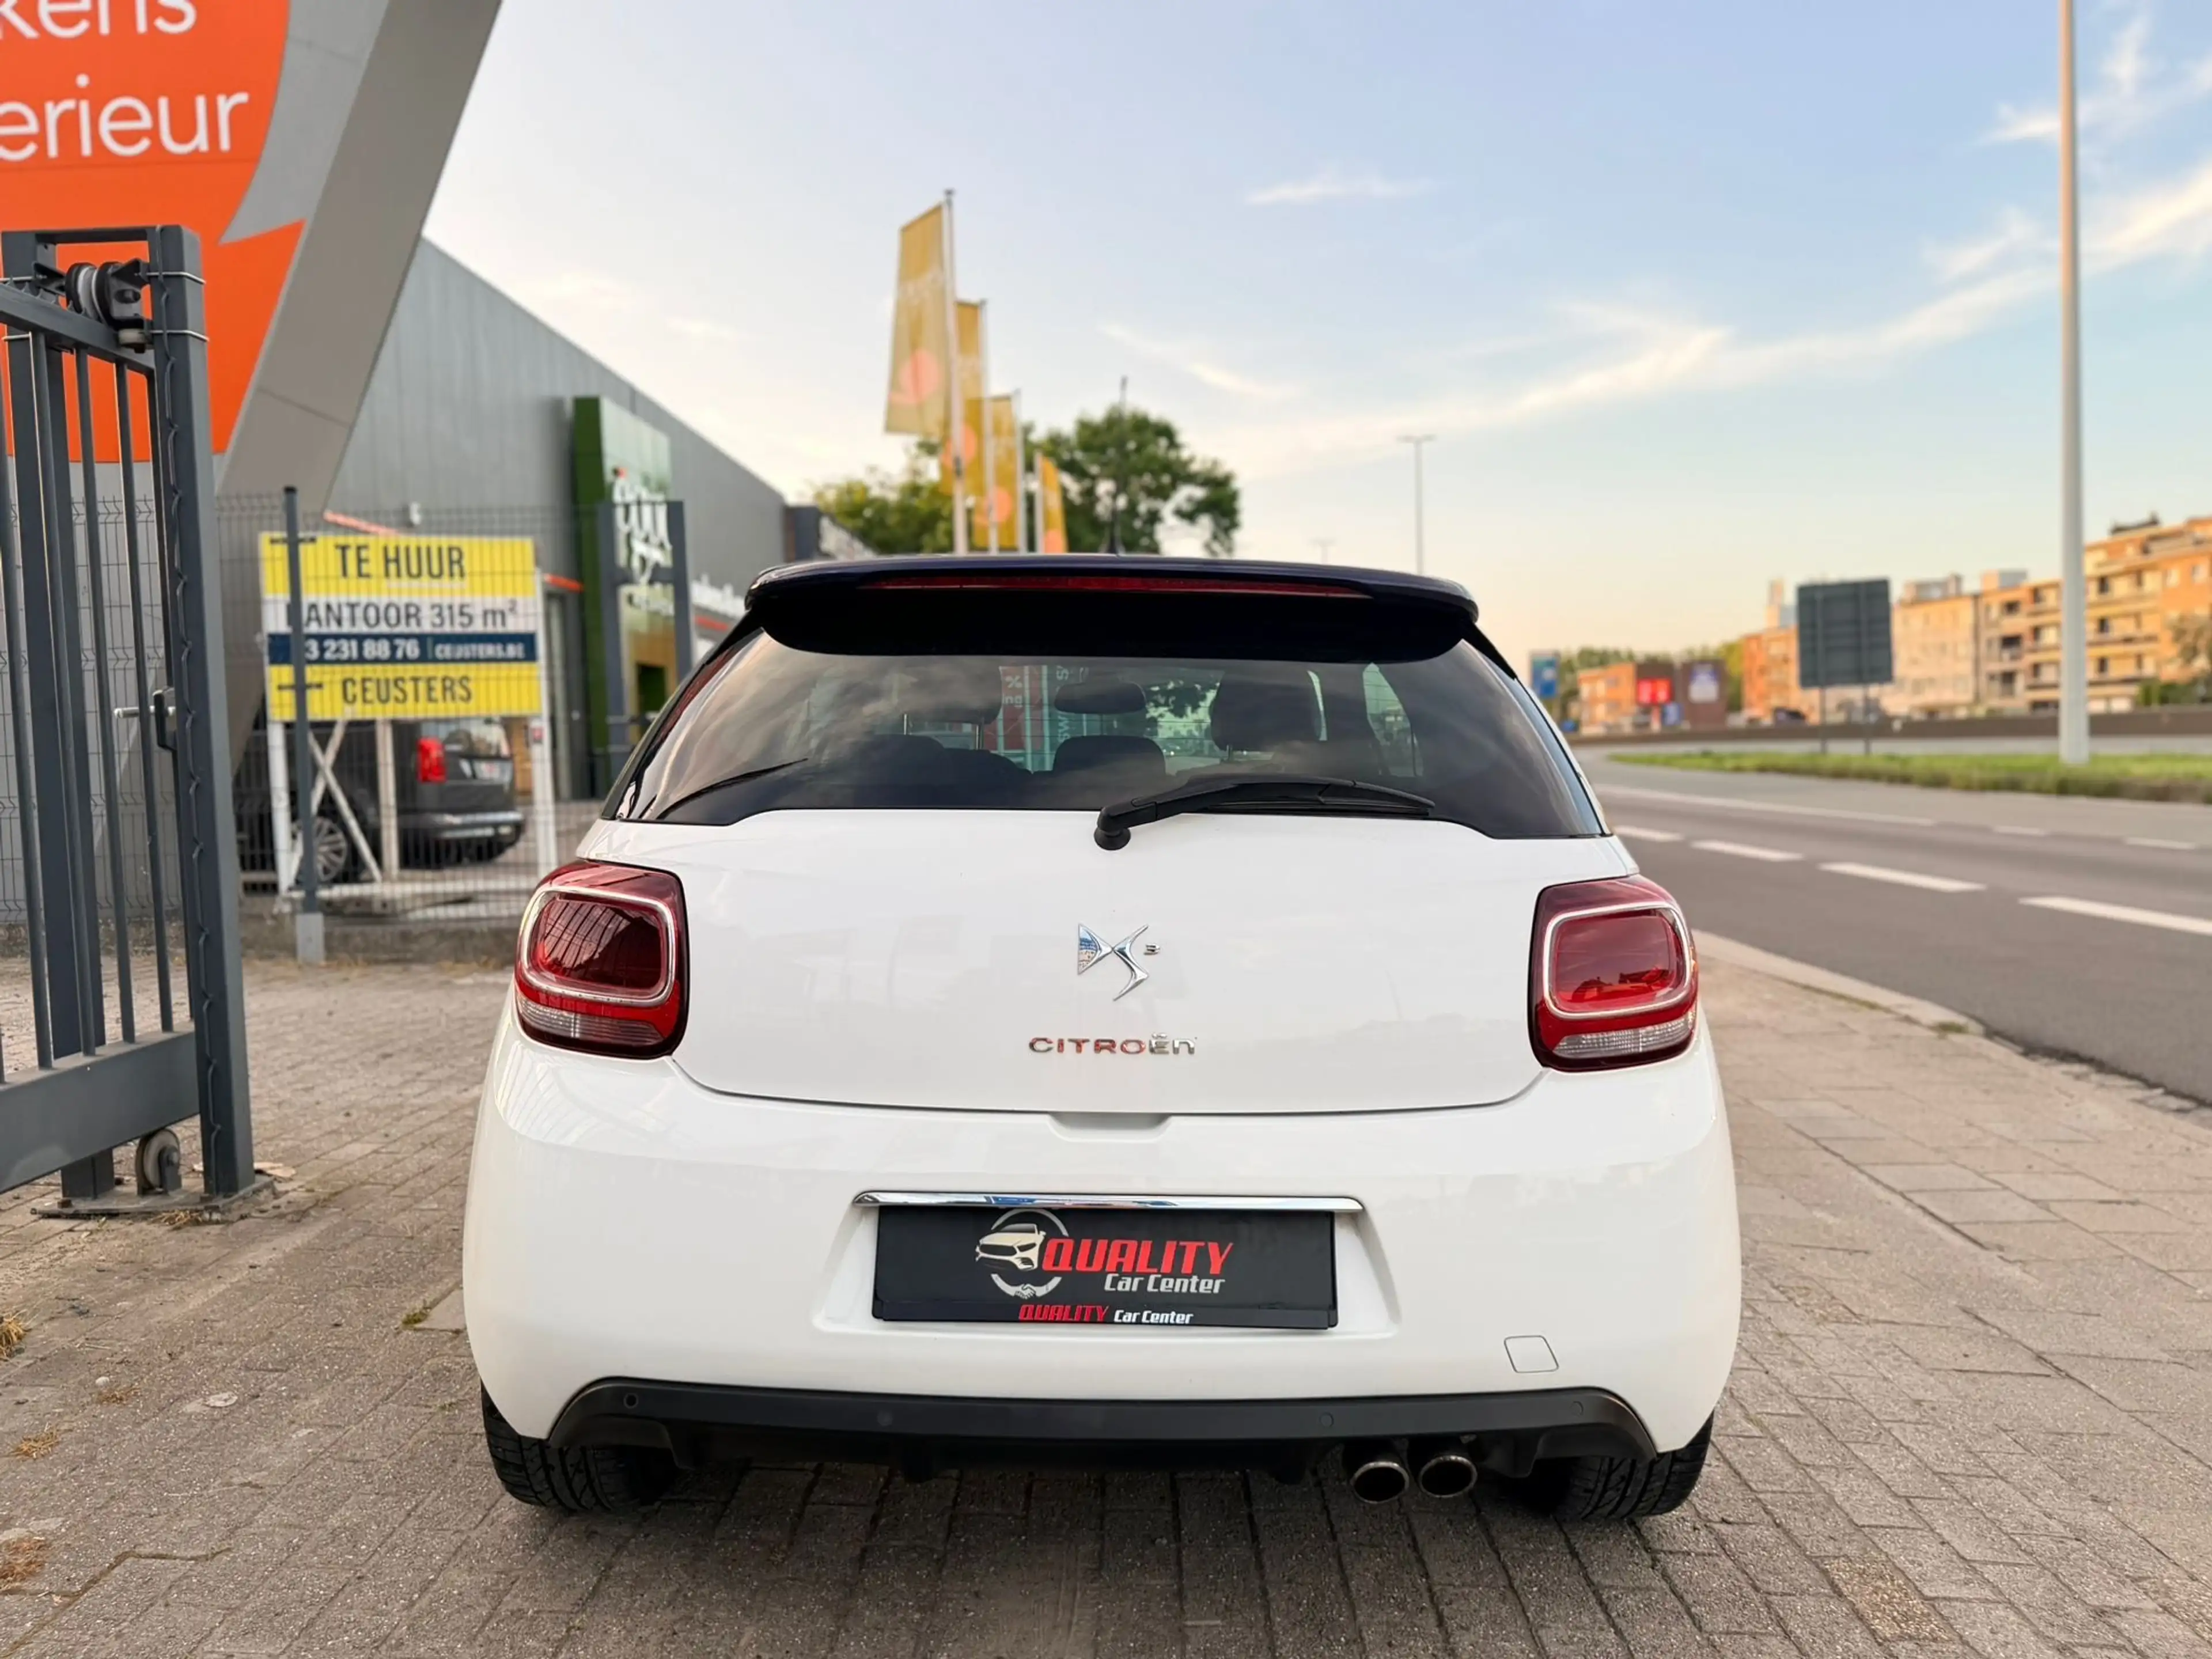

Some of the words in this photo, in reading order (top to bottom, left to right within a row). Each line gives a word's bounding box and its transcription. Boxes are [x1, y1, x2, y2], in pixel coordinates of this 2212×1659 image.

[0, 74, 249, 161] erieur
[334, 543, 372, 579] TE
[382, 544, 467, 580] HUUR
[287, 602, 421, 628] ANTOOR
[430, 603, 474, 628] 315
[323, 638, 359, 661] 231
[362, 639, 391, 661] 88
[393, 638, 420, 660] 76
[342, 676, 473, 704] CEUSTERS
[1042, 1238, 1234, 1275] QUALITY
[1104, 1273, 1144, 1292] Car
[1147, 1274, 1226, 1294] Center
[1018, 1304, 1109, 1322] QUALITY
[1113, 1309, 1141, 1323] Car
[1141, 1310, 1194, 1325] Center
